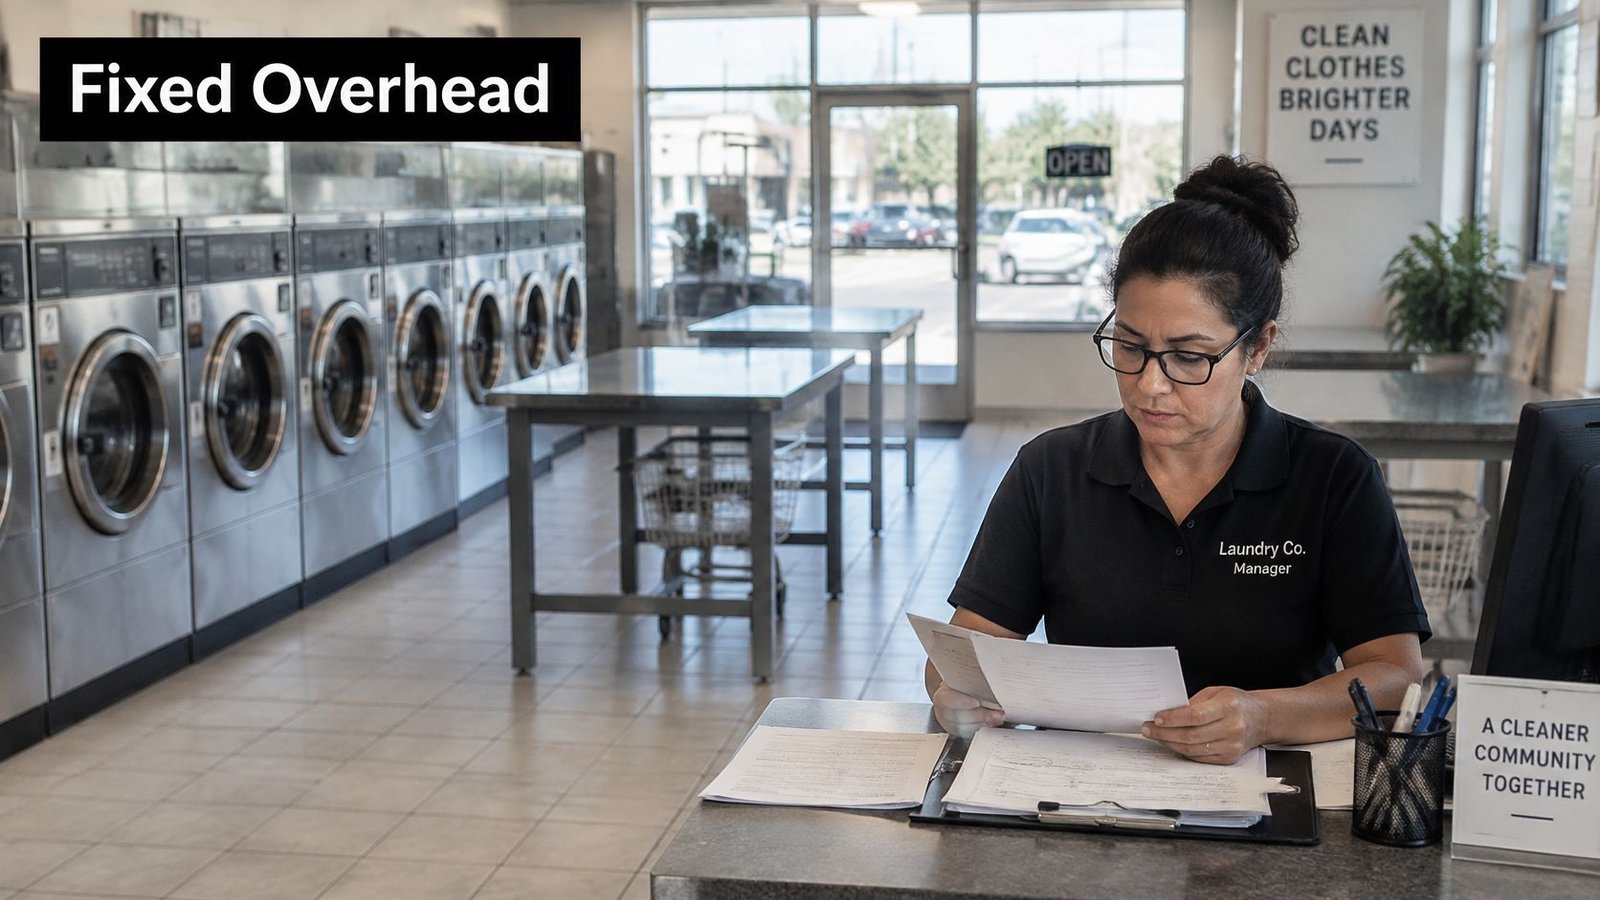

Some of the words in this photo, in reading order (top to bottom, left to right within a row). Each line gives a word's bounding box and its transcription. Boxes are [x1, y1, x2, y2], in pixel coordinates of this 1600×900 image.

[1301, 24, 1389, 47] CLEAN
[1286, 55, 1405, 79] CLOTHES
[1280, 87, 1411, 110] BRIGHTER
[1310, 119, 1379, 141] DAYS
[1047, 149, 1109, 175] OPEN
[1219, 541, 1279, 559] Laundry
[1283, 540, 1306, 556] Co.
[1233, 562, 1292, 578] Manager
[1482, 717, 1495, 735] A
[1500, 718, 1589, 743] CLEANER
[1475, 743, 1596, 772] COMMUNITY
[1483, 773, 1585, 800] TOGETHER
